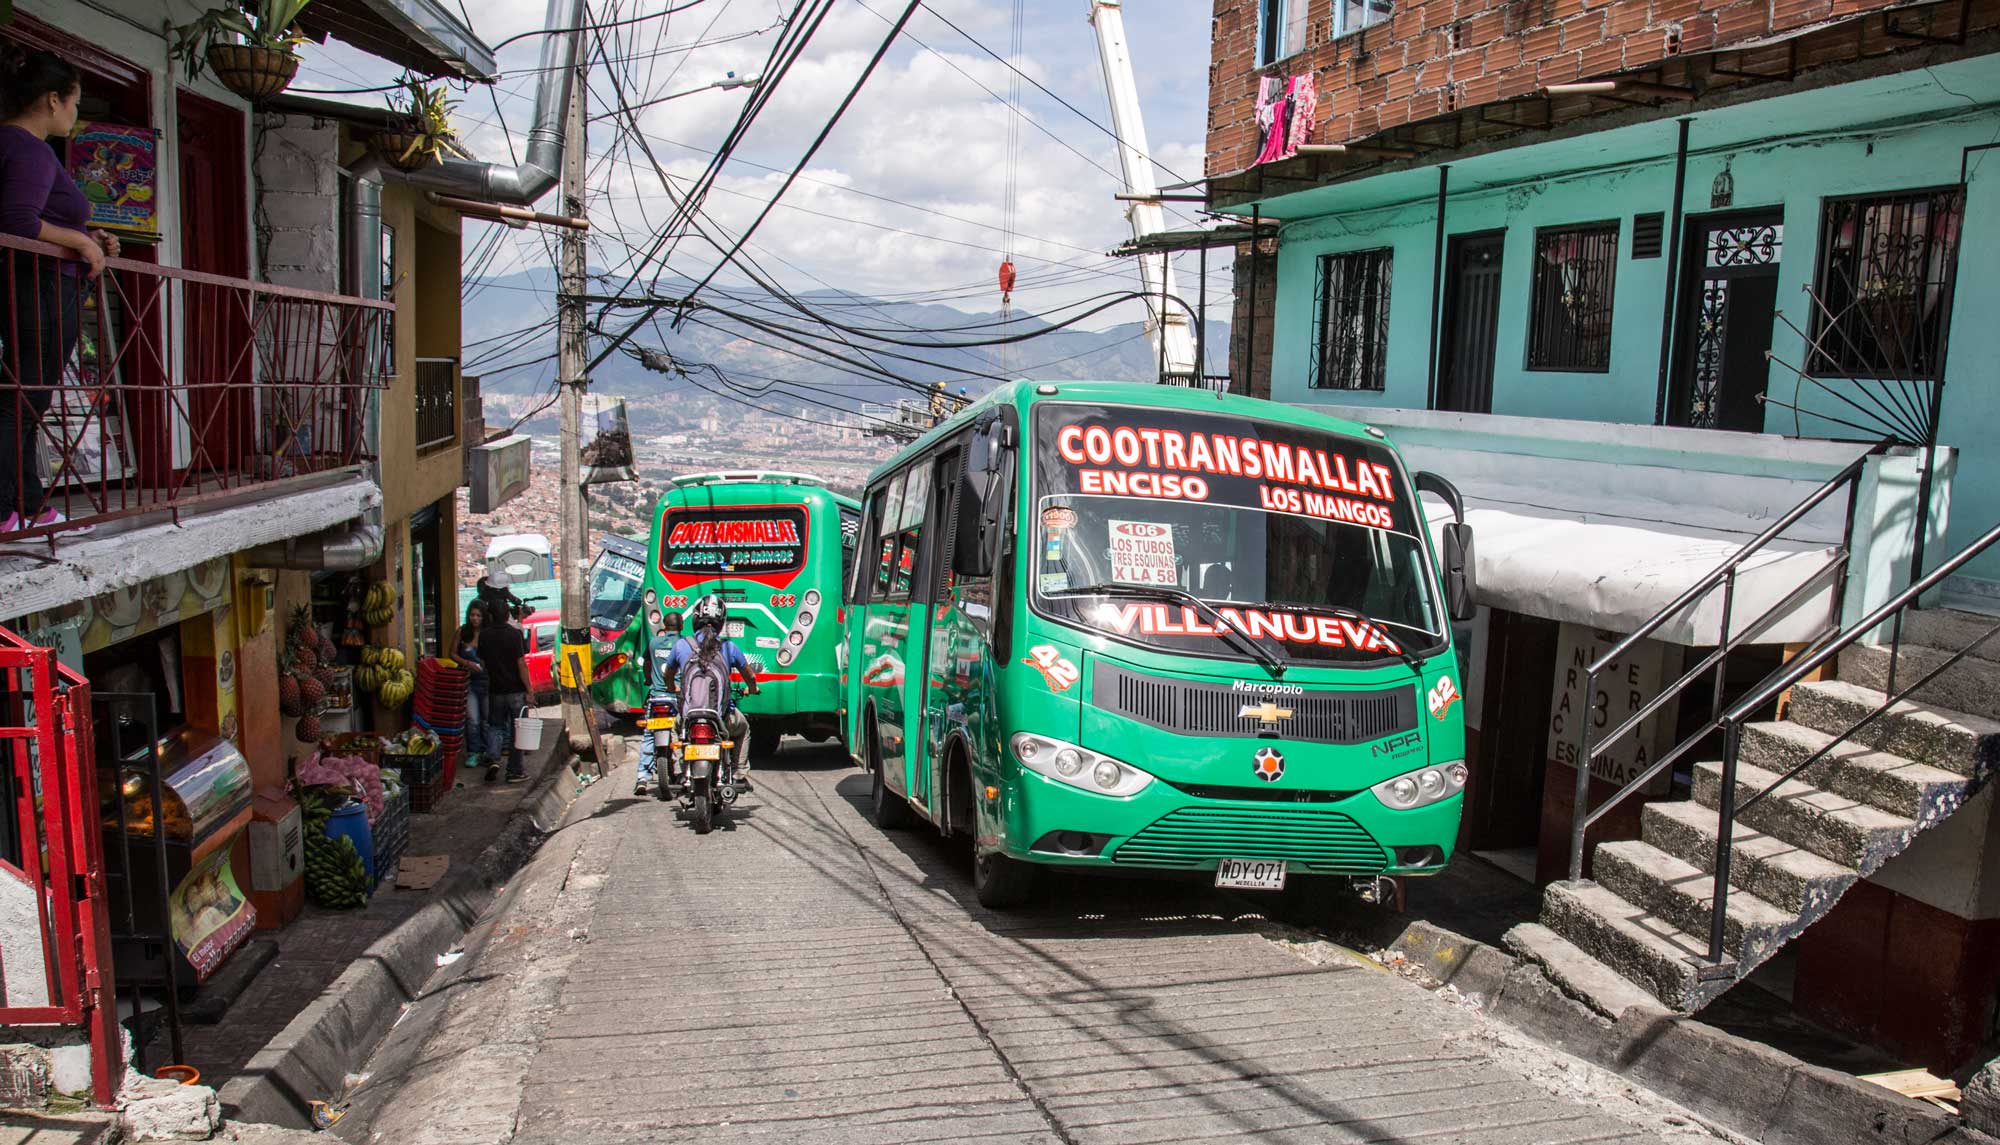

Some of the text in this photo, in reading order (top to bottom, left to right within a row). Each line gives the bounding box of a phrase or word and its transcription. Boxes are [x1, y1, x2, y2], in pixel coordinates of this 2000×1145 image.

[1058, 425, 1396, 502] COOTRANSMALLAT
[1079, 469, 1209, 501] ENCISO
[1259, 485, 1394, 529] LOS MANGOS
[669, 519, 801, 549] COOTRANSMALLAT
[1125, 523, 1158, 536] 106
[730, 551, 750, 565] LOS
[751, 550, 794, 565] MANGOS
[1111, 537, 1173, 555] LOS TUBOS
[1114, 566, 1176, 583] X LA 58
[1134, 554, 1175, 569] ESQUINAS
[663, 595, 688, 608] 033
[770, 594, 796, 607] 033
[1098, 602, 1402, 655] VILLANUEVA
[1029, 645, 1079, 691] 42
[1232, 679, 1303, 696] Marcopolo
[1427, 675, 1456, 715] 42
[1594, 690, 1609, 728] 3
[1371, 731, 1422, 758] NPR
[191, 953, 201, 963] El
[200, 911, 257, 980] pollo apanado
